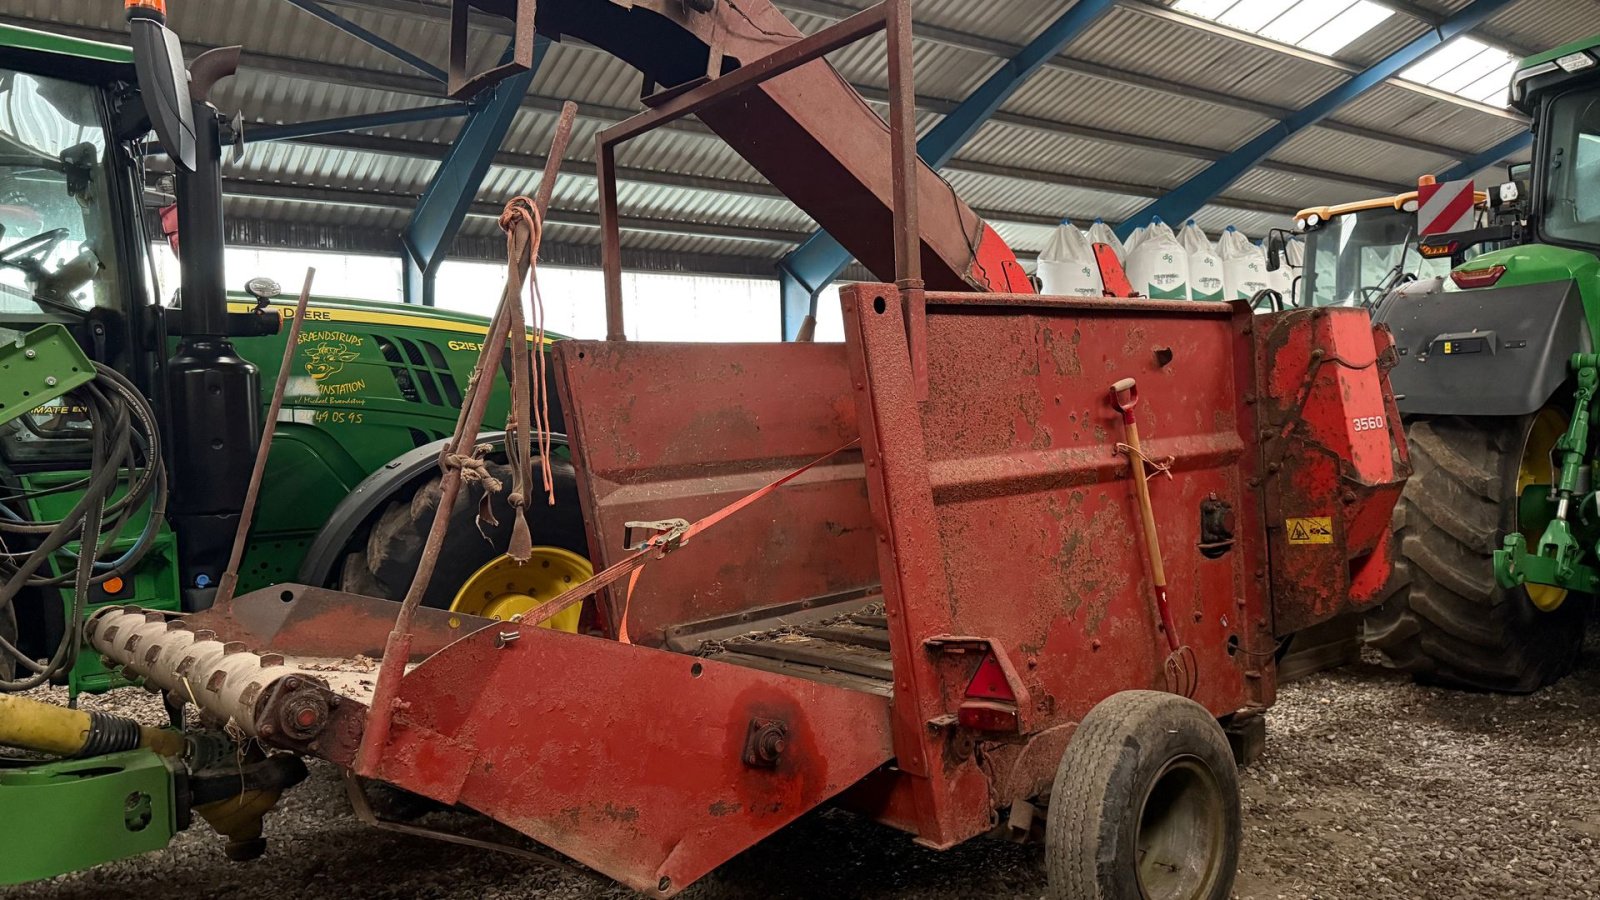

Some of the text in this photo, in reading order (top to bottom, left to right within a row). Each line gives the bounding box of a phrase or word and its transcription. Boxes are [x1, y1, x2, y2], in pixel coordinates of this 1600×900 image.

[283, 307, 331, 320] DERE
[314, 410, 329, 423] 49
[332, 411, 346, 423] 05
[347, 412, 363, 424] 95
[1352, 415, 1384, 432] 3560
